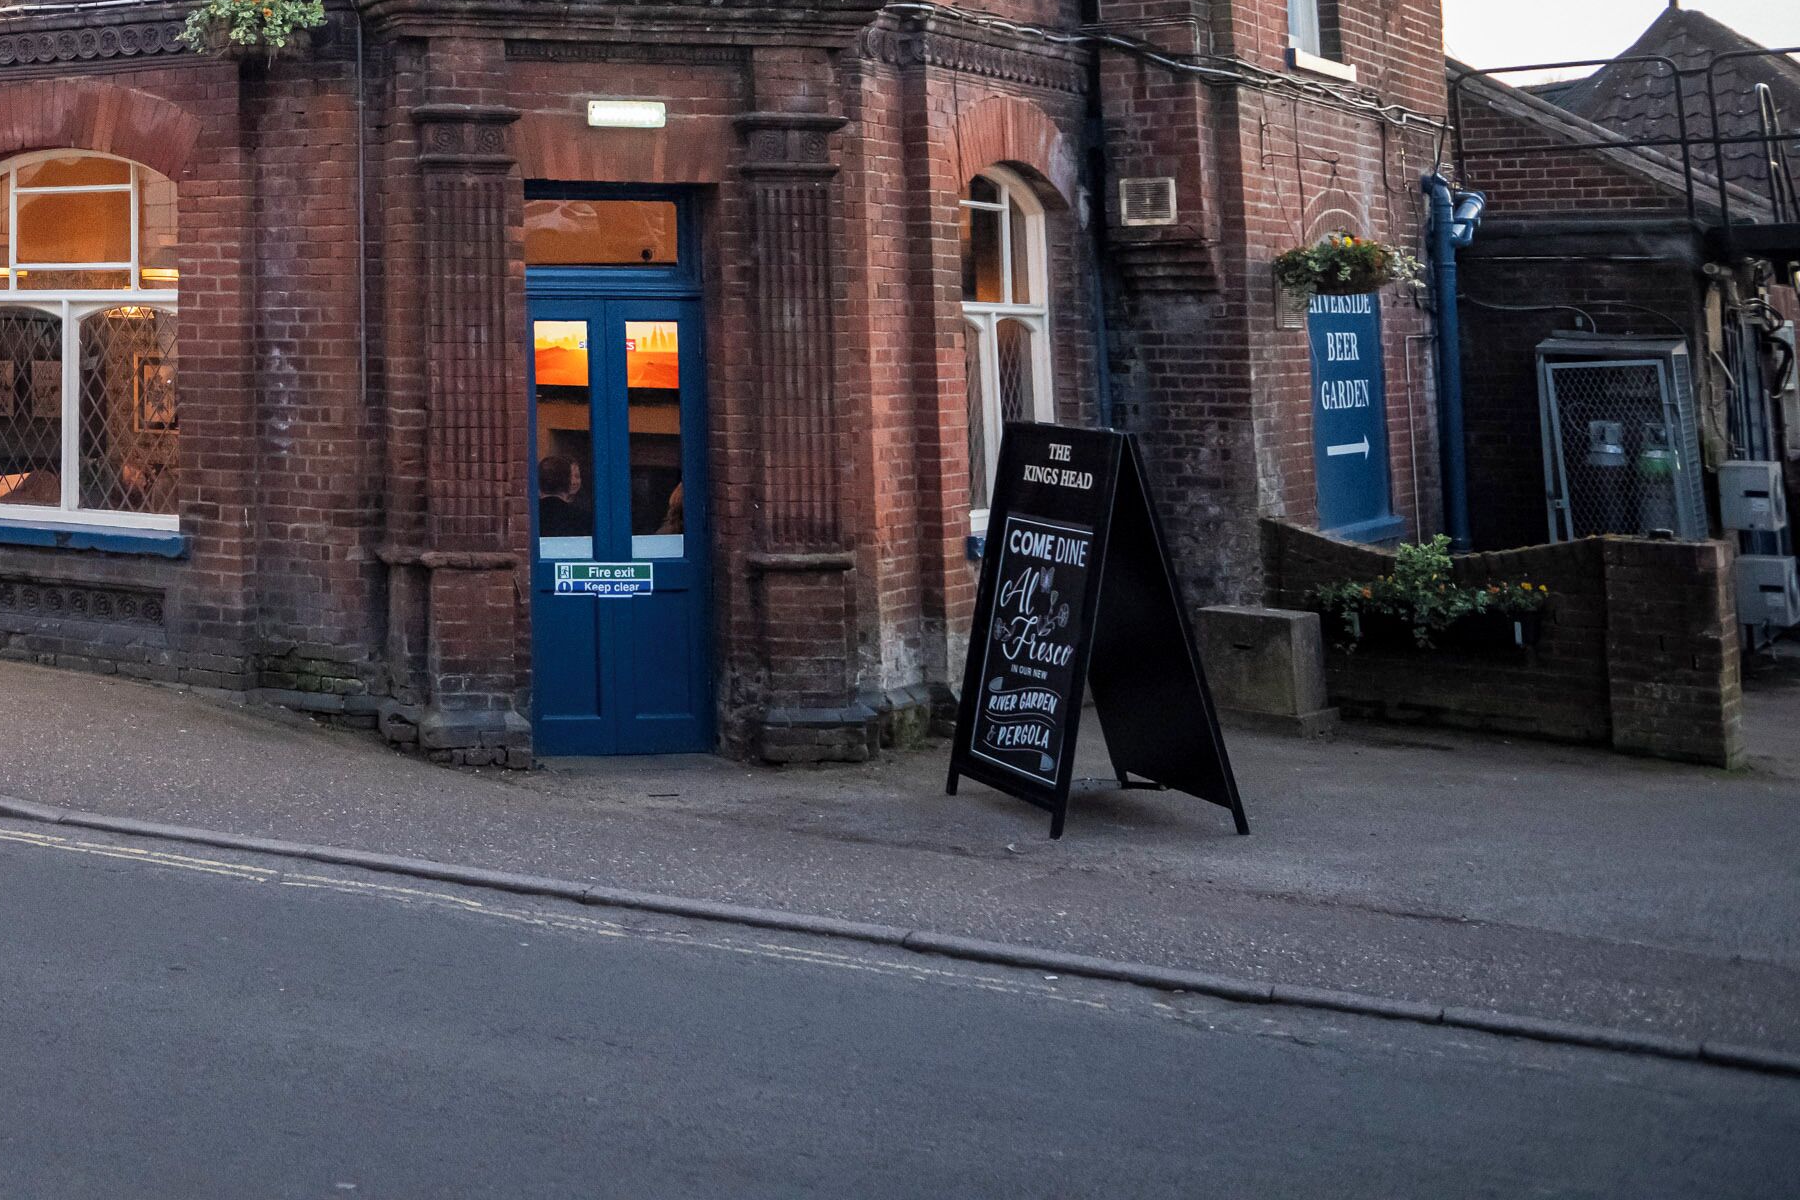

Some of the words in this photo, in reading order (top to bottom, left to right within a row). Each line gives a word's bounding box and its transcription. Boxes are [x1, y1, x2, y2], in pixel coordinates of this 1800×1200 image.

[1326, 332, 1360, 361] BEER
[1321, 379, 1370, 410] GARDEN
[1048, 443, 1072, 461] THE
[1023, 464, 1059, 485] KINGS
[1060, 469, 1093, 489] HEAD
[1009, 529, 1055, 560] COME
[1055, 537, 1089, 567] DINE
[588, 567, 611, 577] Fire
[614, 567, 635, 577] exit
[584, 582, 611, 594] Keep
[614, 582, 639, 592] clear
[1000, 566, 1039, 615] Al
[1002, 616, 1074, 666] Fresco
[1010, 664, 1018, 674] IN
[1018, 665, 1032, 676] OUR
[1032, 667, 1048, 680] NEW
[988, 694, 1018, 711] RIVER
[1019, 691, 1057, 714] GARDEN
[997, 724, 1049, 749] PERGOLA
